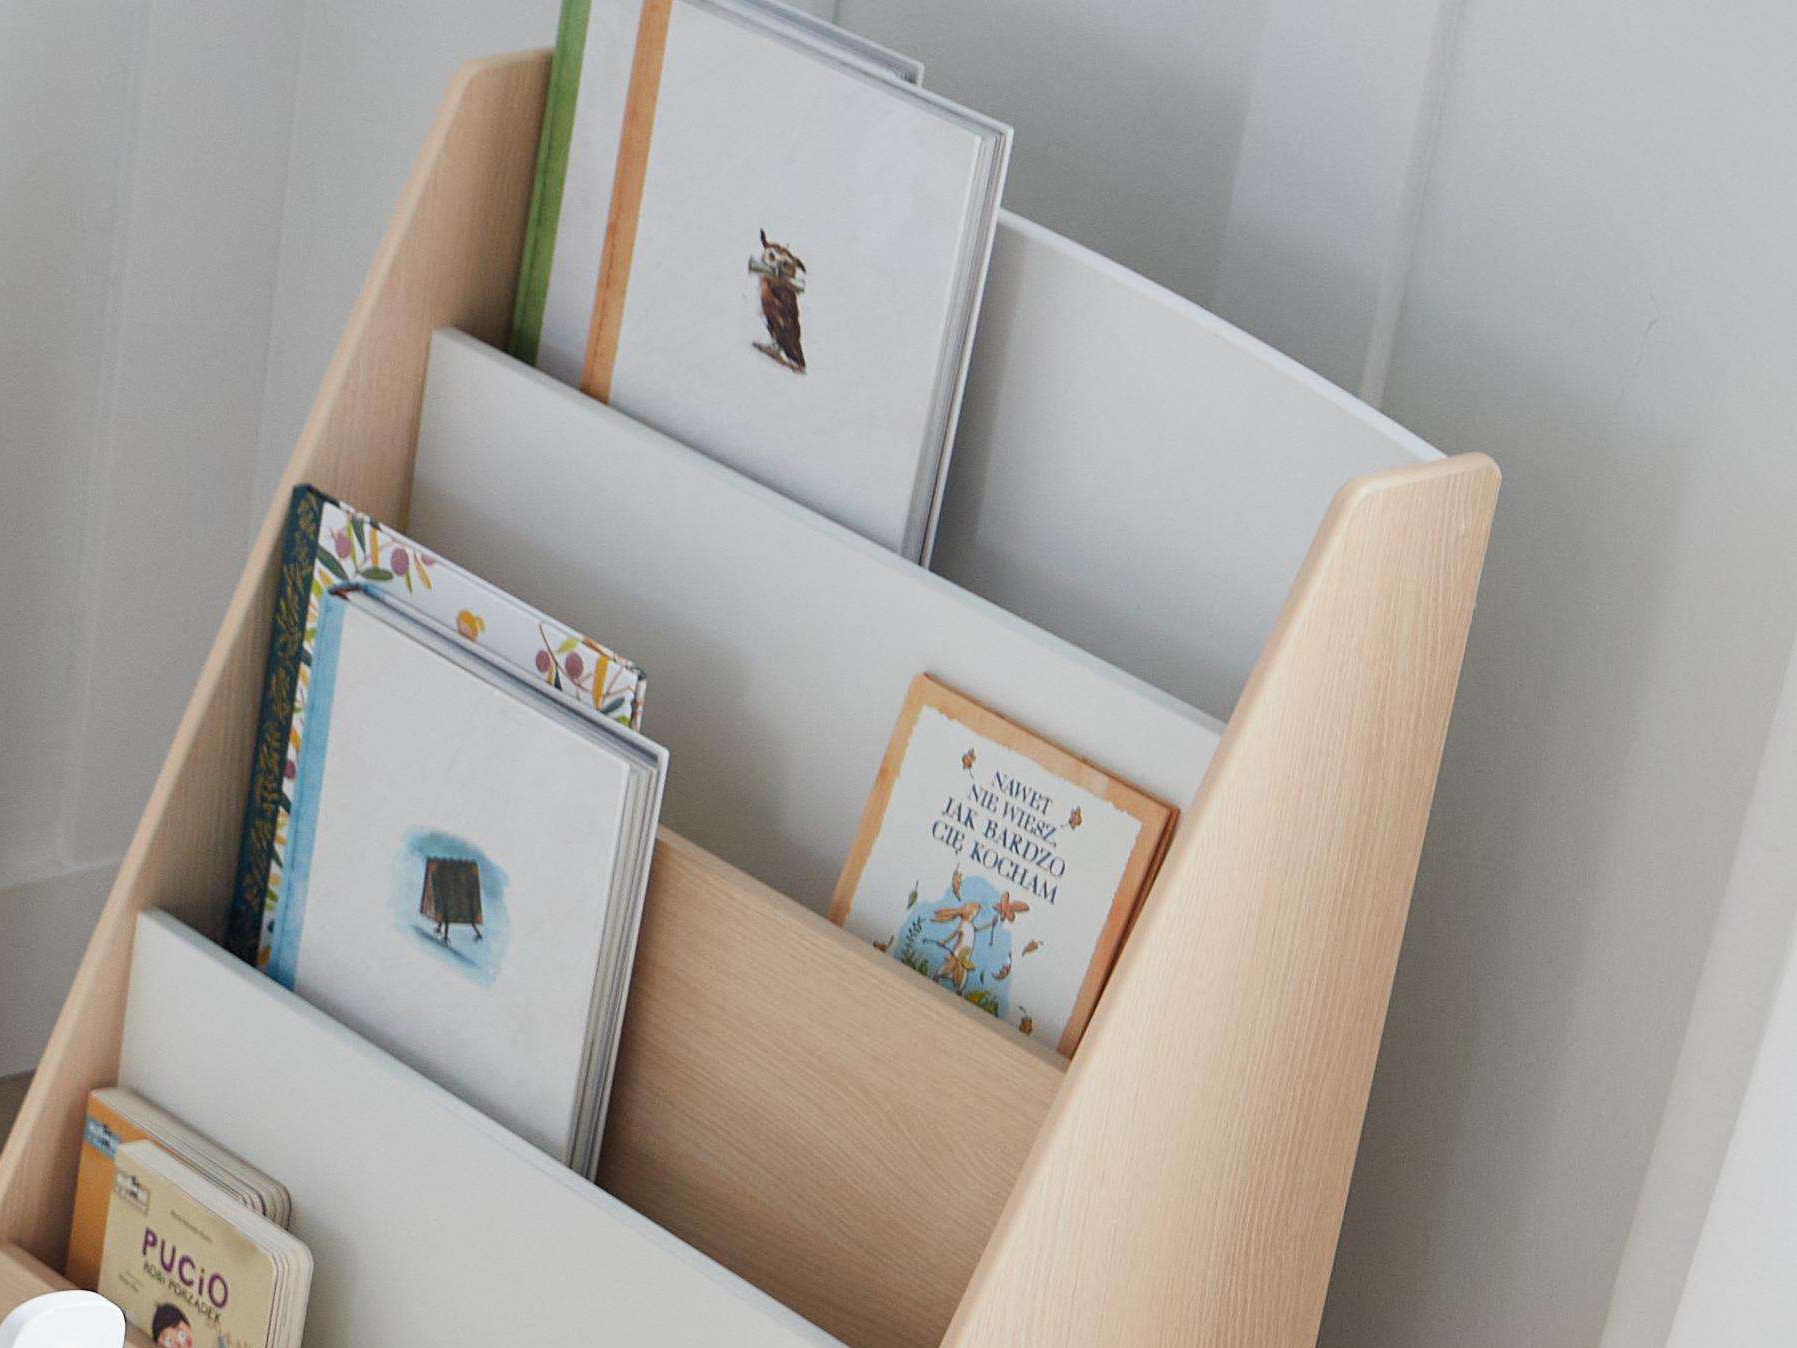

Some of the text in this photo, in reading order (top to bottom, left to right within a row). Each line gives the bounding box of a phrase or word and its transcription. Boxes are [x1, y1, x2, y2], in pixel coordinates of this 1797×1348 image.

[968, 783, 999, 813] NIE
[991, 769, 1053, 816] NAWET
[931, 820, 1058, 905] CIĘ KOCHAM
[941, 797, 1066, 878] JAK BARDZO
